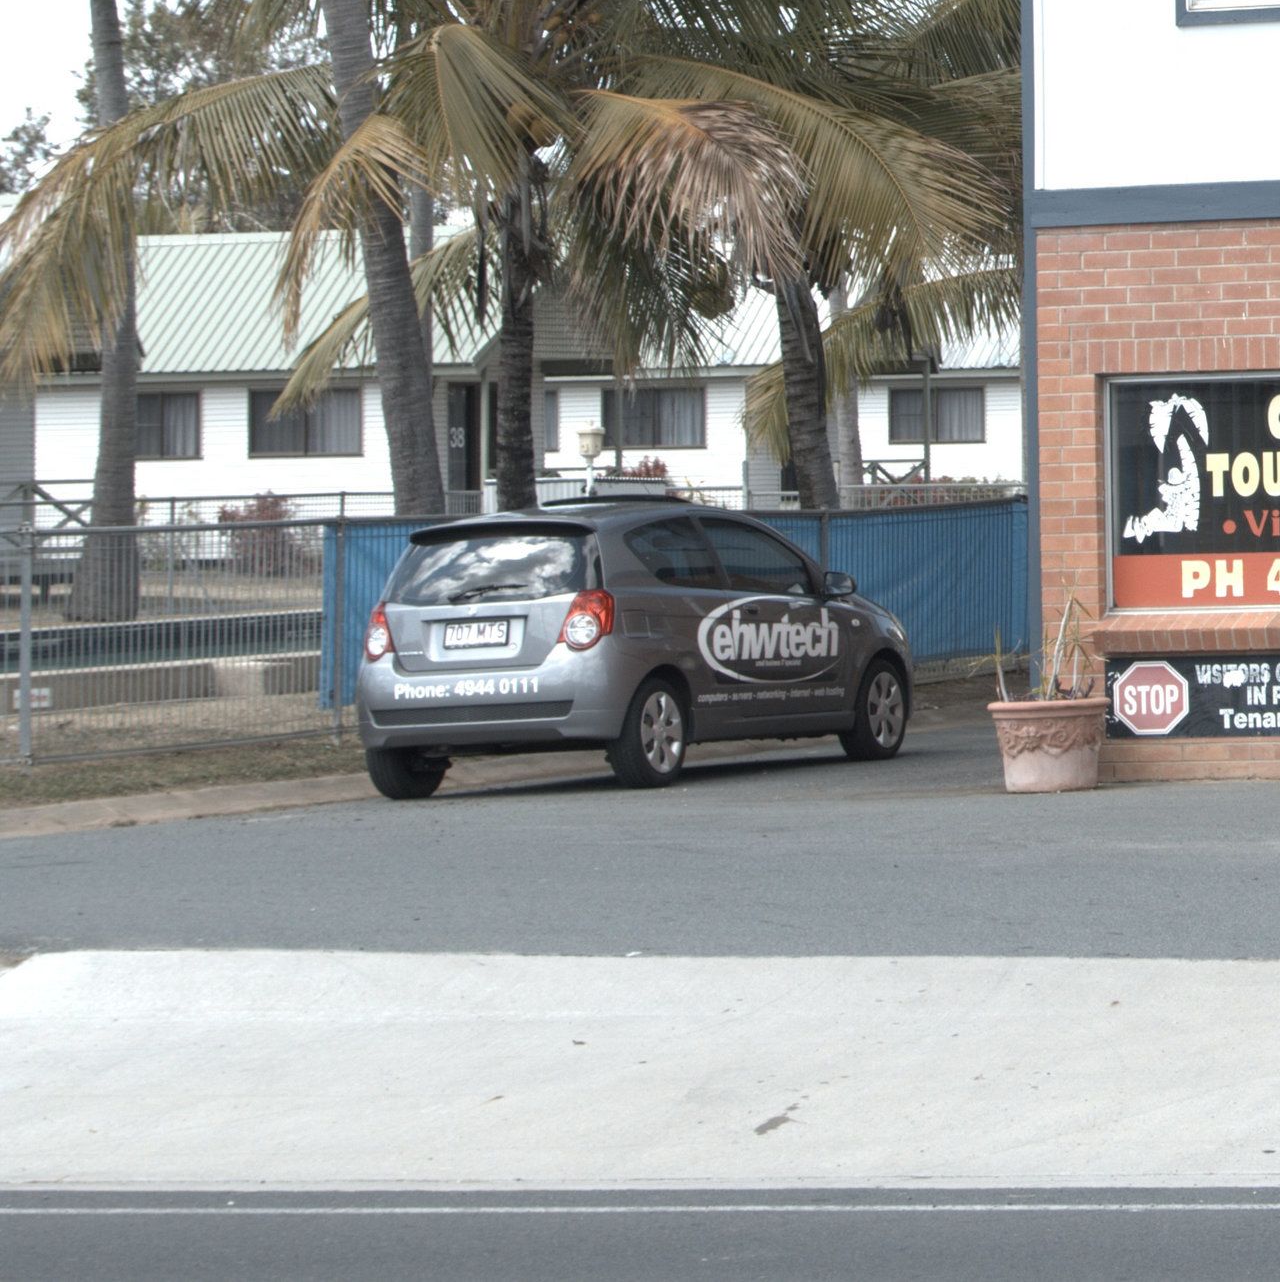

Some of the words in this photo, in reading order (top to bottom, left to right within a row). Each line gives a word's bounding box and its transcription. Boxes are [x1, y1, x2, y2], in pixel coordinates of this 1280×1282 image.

[450, 427, 465, 448] 38
[1181, 559, 1244, 598] PH
[448, 625, 472, 641] 707
[477, 623, 506, 639] MTS
[713, 607, 839, 661] ehwtech
[394, 683, 450, 700] Phone:
[454, 679, 495, 696] 4944
[499, 677, 539, 694] 0111
[1123, 683, 1179, 716] STOP
[1246, 686, 1267, 706] IN
